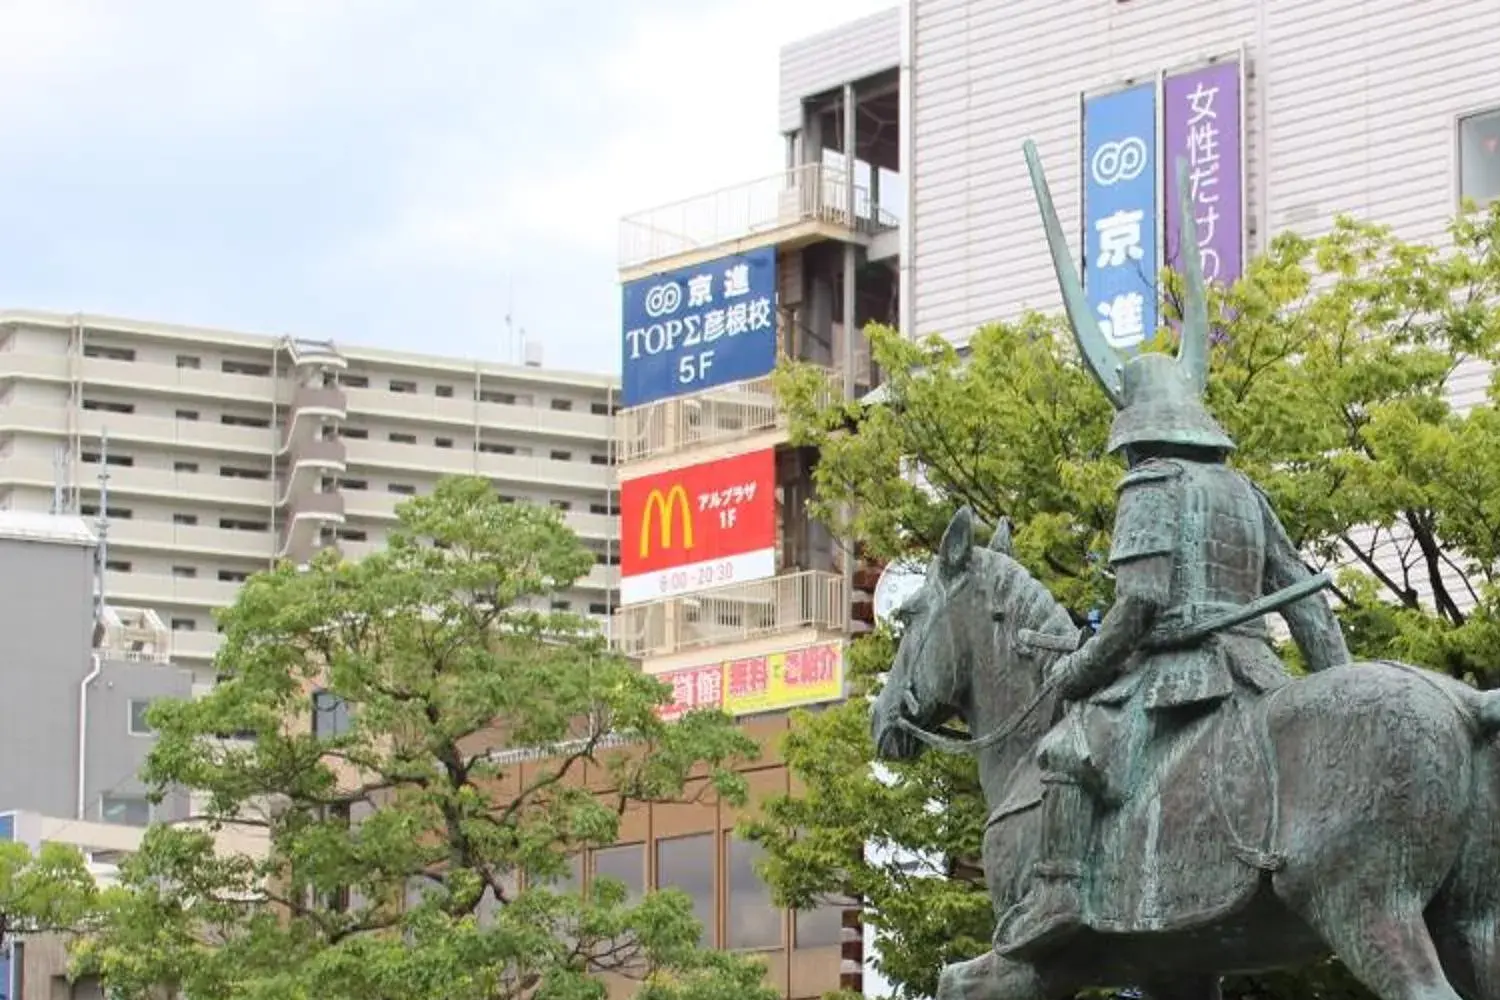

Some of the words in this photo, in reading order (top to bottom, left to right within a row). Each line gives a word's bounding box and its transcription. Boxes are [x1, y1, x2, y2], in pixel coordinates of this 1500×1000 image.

[688, 264, 750, 307] 京進
[1095, 208, 1146, 348] 京進
[678, 350, 716, 384] 5F
[719, 507, 737, 529] 1F
